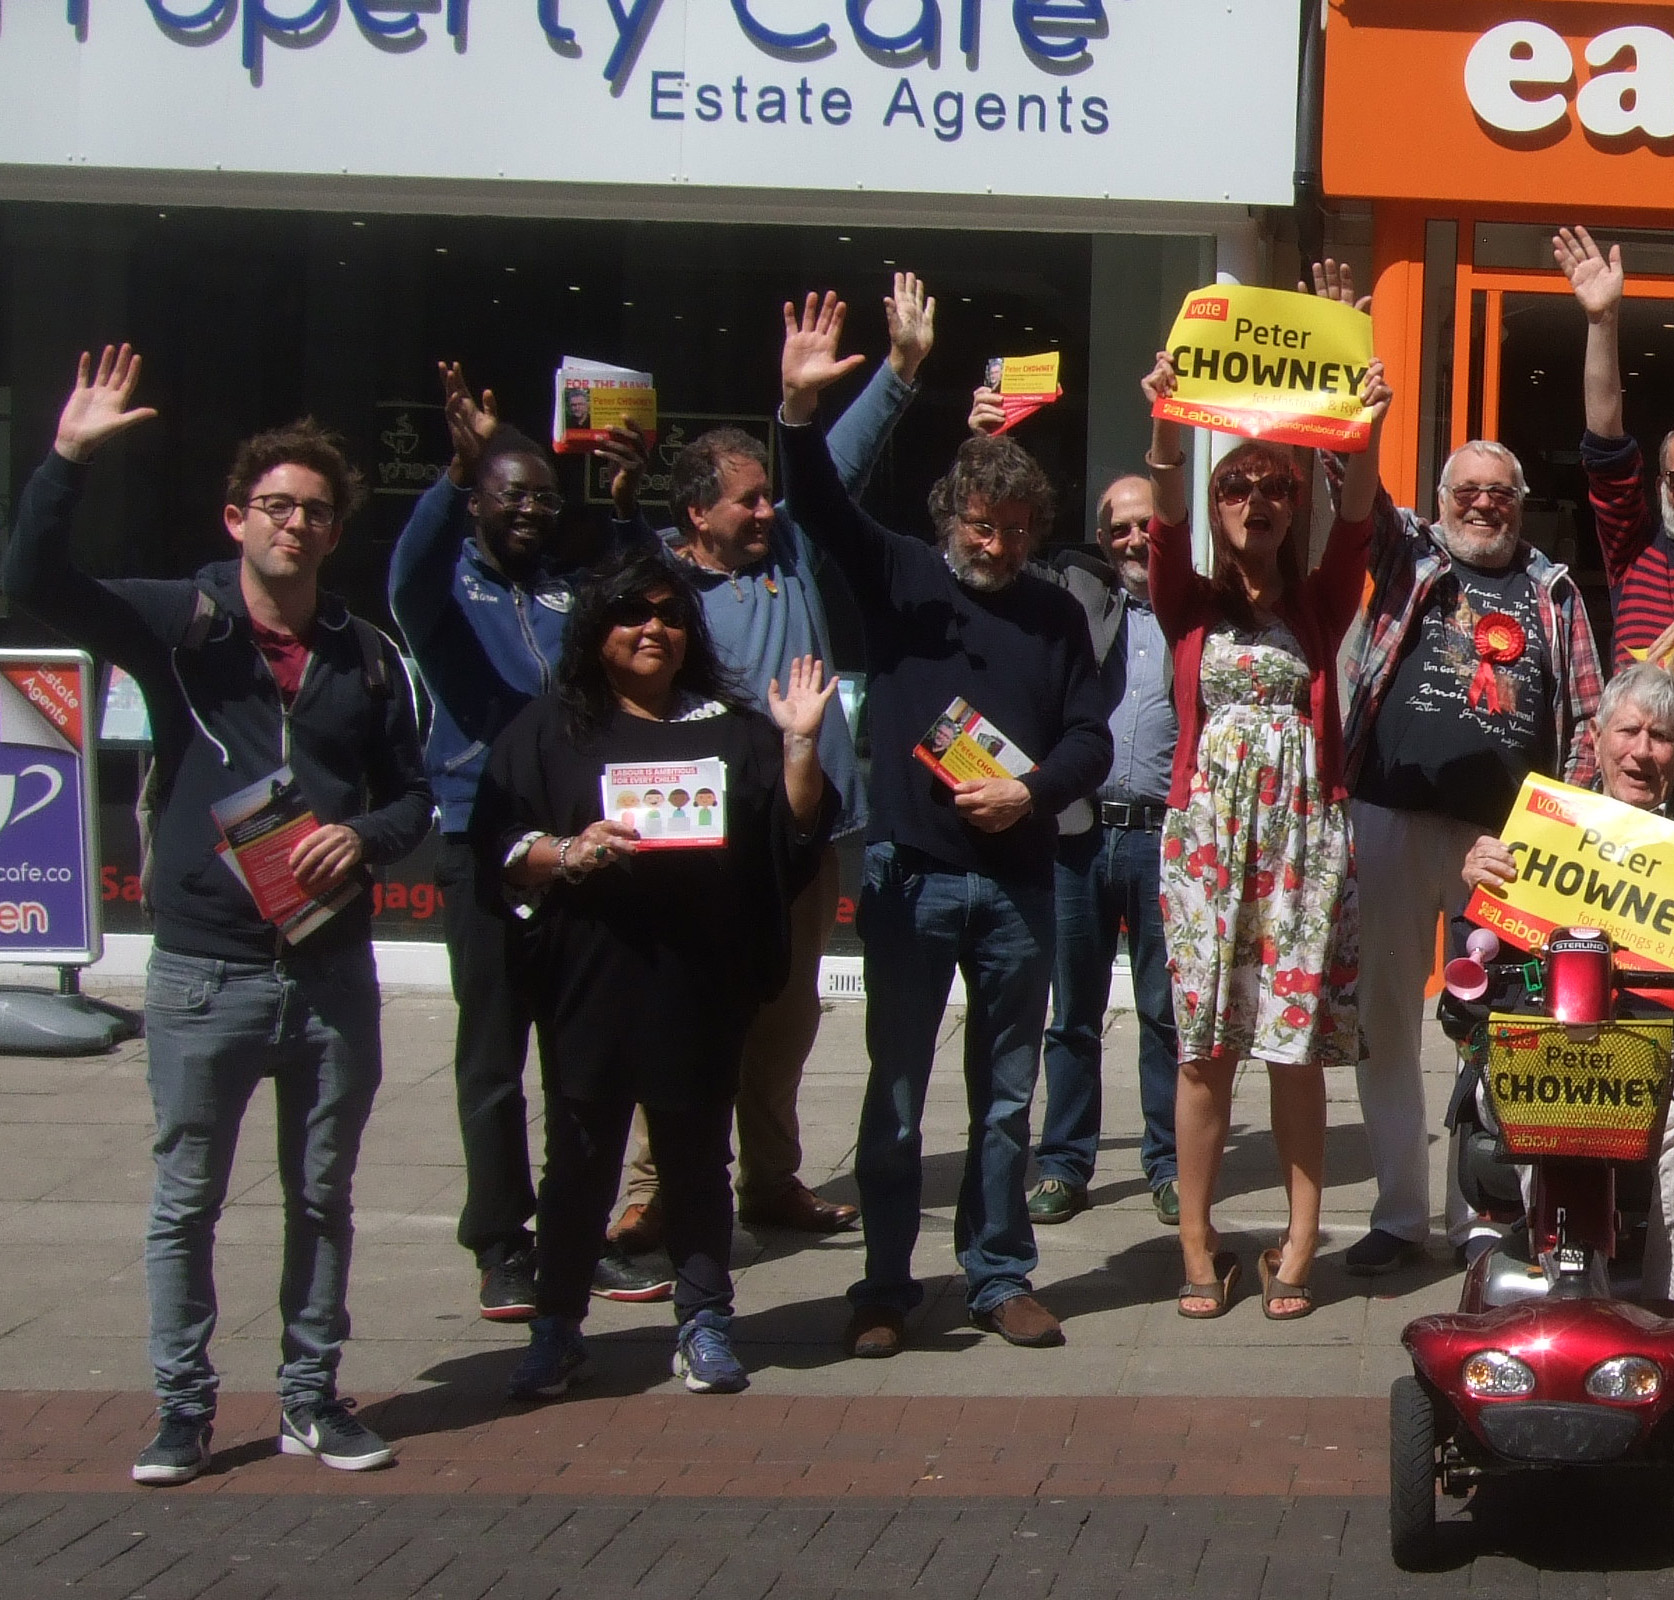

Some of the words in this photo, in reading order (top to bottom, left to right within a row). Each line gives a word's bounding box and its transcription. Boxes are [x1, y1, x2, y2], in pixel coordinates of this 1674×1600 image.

[651, 70, 853, 124] Estate
[883, 77, 1110, 142] Agents
[1190, 301, 1221, 316] vote
[1234, 318, 1312, 349] Peter
[593, 379, 616, 389] THE
[1172, 345, 1368, 396] CHOWNEY
[1180, 407, 1242, 429] Labour
[22, 677, 69, 726] Agents
[38, 663, 79, 709] Estate
[1535, 795, 1573, 820] vote
[1577, 828, 1662, 878] Peter
[1555, 940, 1605, 952] STERLING
[1577, 911, 1596, 928] for
[1598, 917, 1653, 950] Hastings
[1547, 1047, 1615, 1069] Peter
[1494, 1072, 1664, 1107] CHOWNEY
